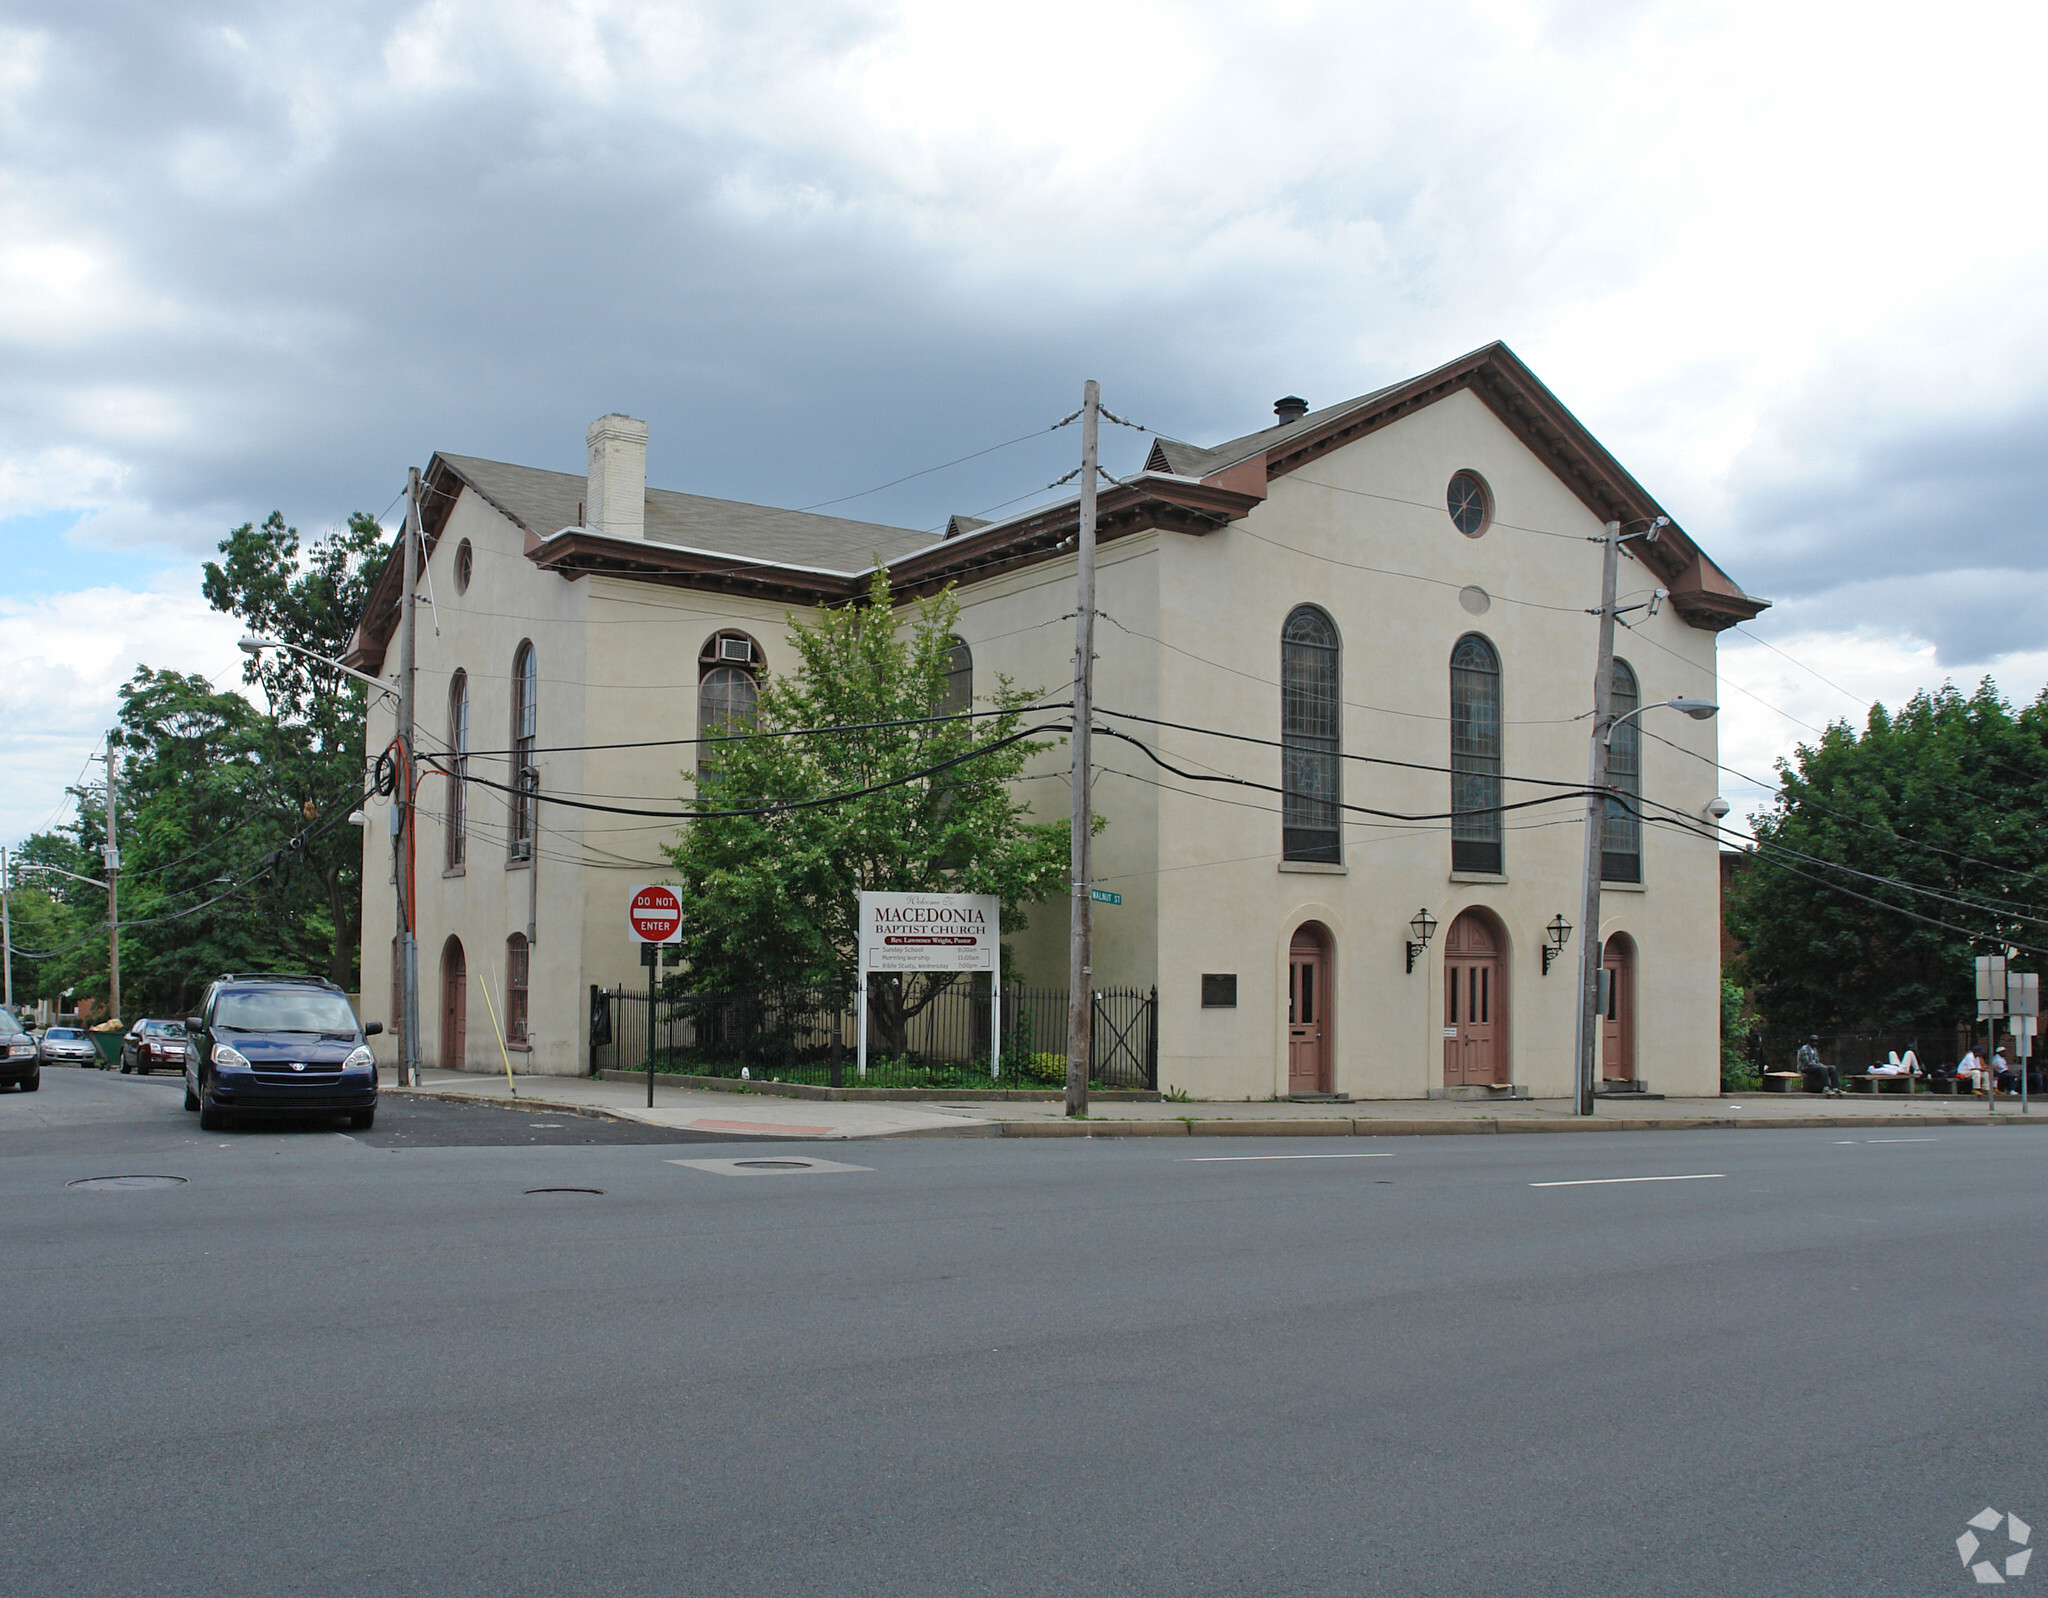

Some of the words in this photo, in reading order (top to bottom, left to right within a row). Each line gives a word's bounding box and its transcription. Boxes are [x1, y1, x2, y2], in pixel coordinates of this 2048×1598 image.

[638, 897, 650, 906] DO
[656, 897, 674, 906] NOT
[906, 896, 940, 905] Welcome
[942, 896, 954, 906] To
[1092, 890, 1112, 902] WALNUT
[1114, 895, 1121, 904] ST
[875, 908, 985, 923] MACEDONIA
[641, 921, 670, 931] ENTER
[875, 925, 928, 934] BAPTIST
[931, 926, 985, 934] CHURCH
